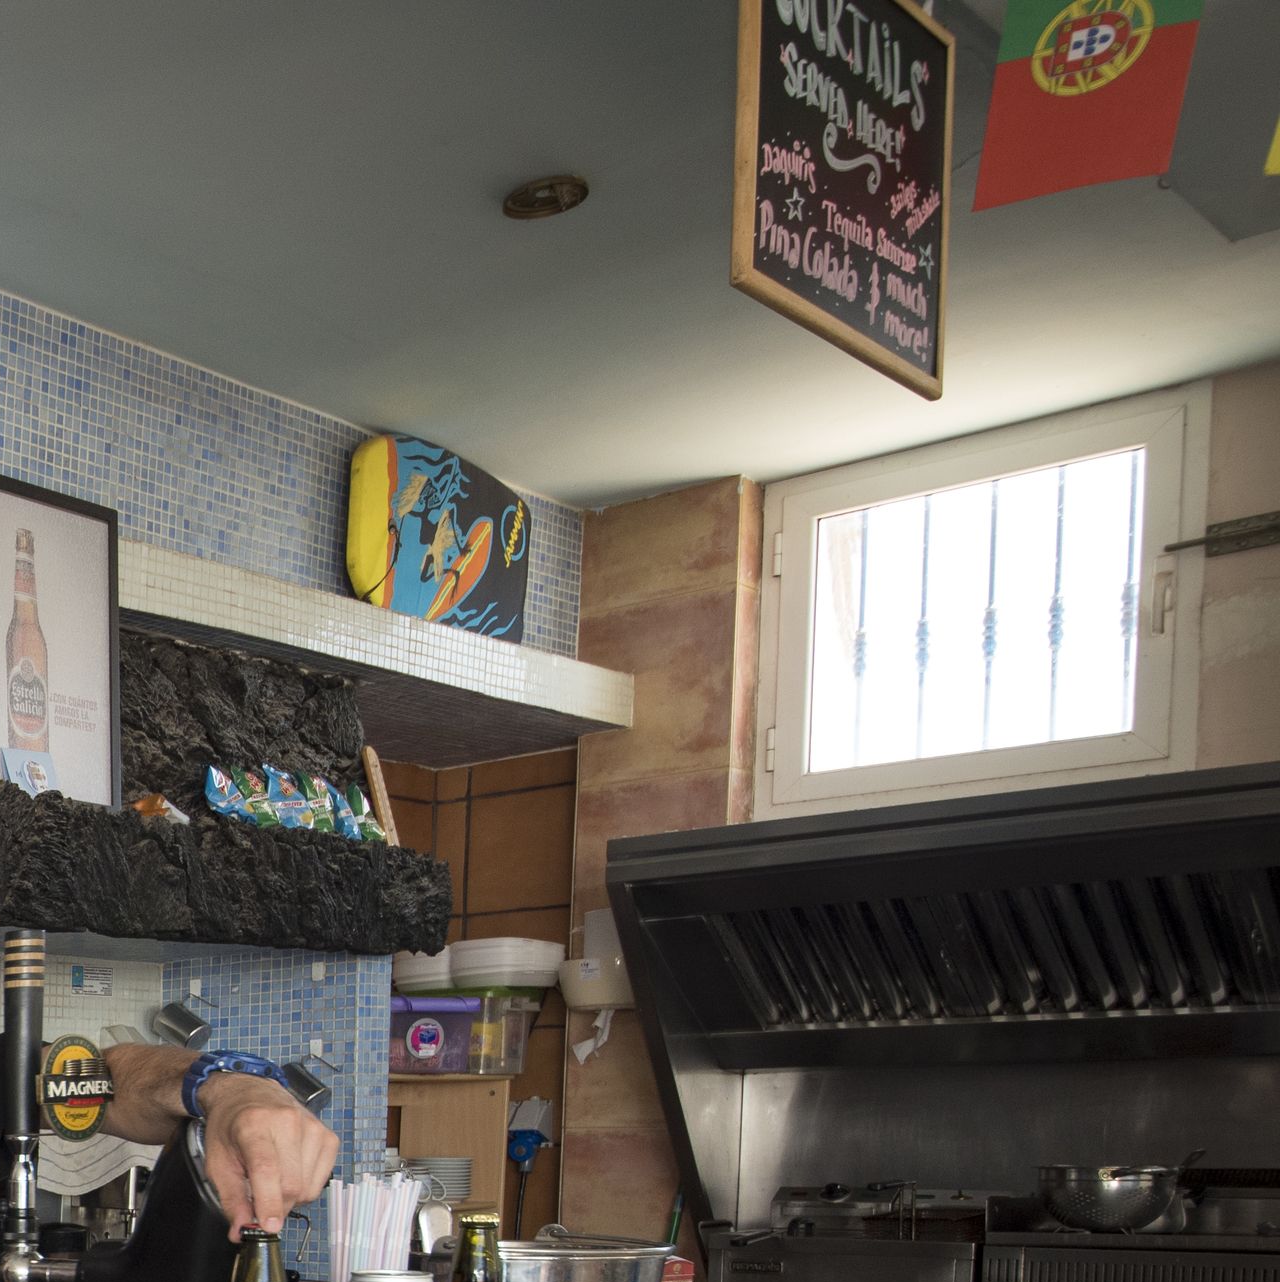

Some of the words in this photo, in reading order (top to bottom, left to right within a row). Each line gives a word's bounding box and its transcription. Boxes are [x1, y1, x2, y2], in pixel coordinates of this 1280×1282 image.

[783, 42, 850, 129] SERVED
[856, 99, 903, 173] HERE!
[802, 226, 858, 302] Colada
[822, 200, 874, 252] Tequila
[876, 227, 917, 275] Sunrise
[886, 272, 927, 321] much
[883, 309, 929, 363] more!
